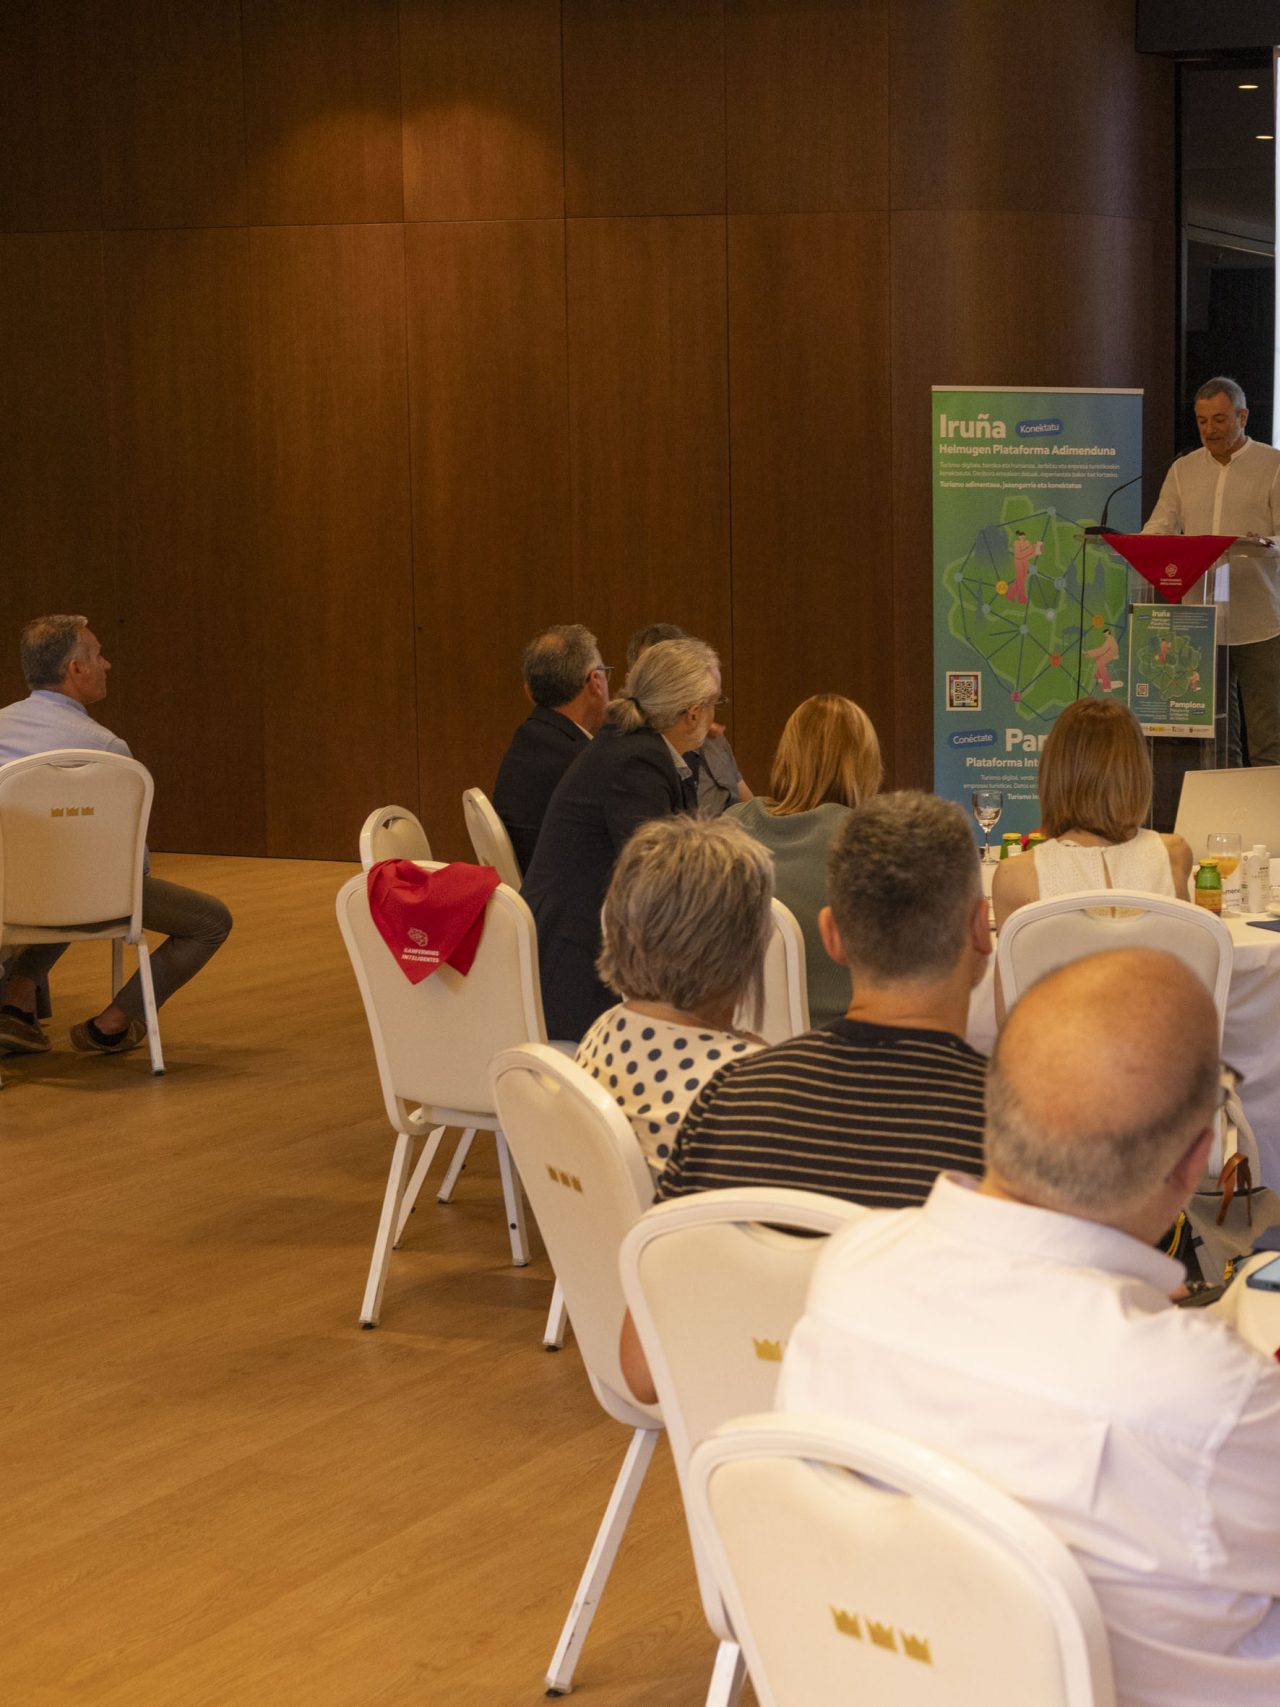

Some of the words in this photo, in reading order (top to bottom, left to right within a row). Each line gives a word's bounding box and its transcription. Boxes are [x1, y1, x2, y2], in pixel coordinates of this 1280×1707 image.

[940, 413, 1006, 438] Iruña
[1019, 424, 1060, 433] Konektatu
[939, 444, 991, 456] Helmugen
[993, 445, 1050, 455] Plataforma
[1052, 445, 1116, 456] Adimenduna
[953, 734, 993, 744] Conéctate
[966, 757, 1022, 767] Plataforma
